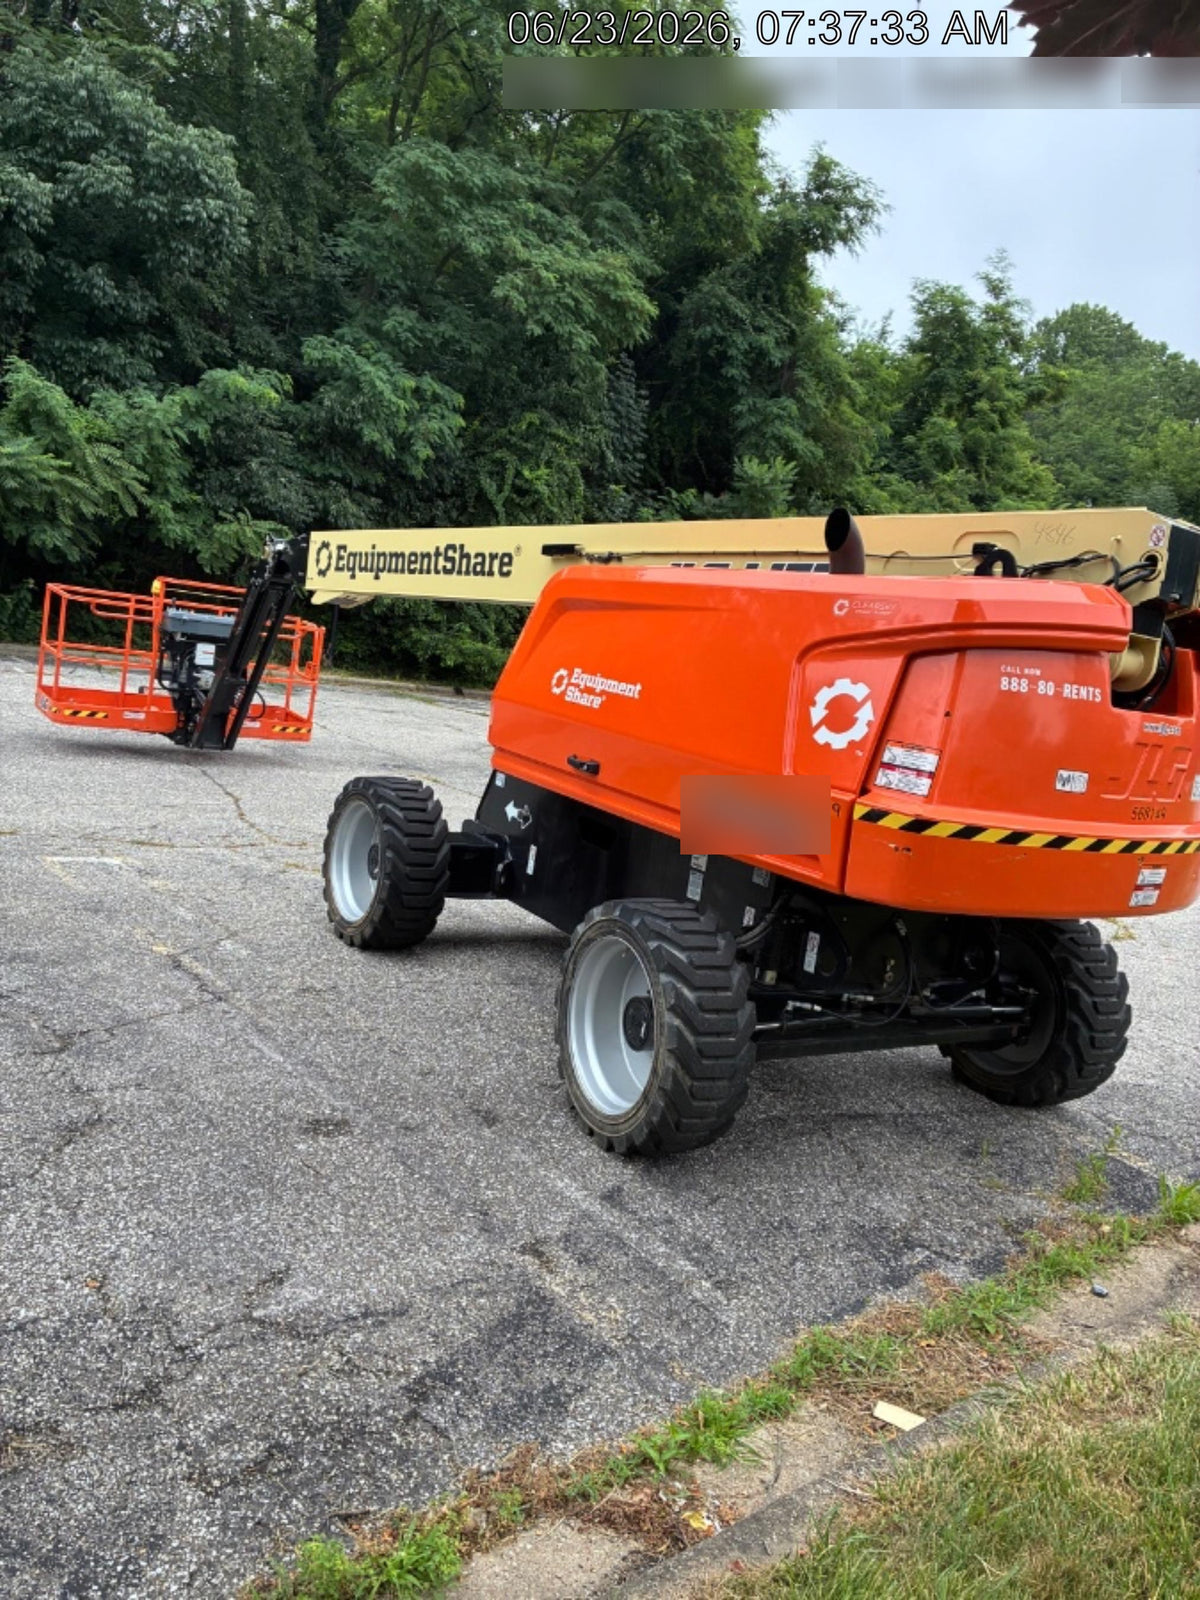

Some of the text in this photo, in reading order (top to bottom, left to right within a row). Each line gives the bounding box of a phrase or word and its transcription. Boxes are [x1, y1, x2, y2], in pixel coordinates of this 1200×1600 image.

[1000, 664, 1042, 677] CALL NOW
[570, 667, 643, 699] Equipment
[564, 685, 602, 709] Share
